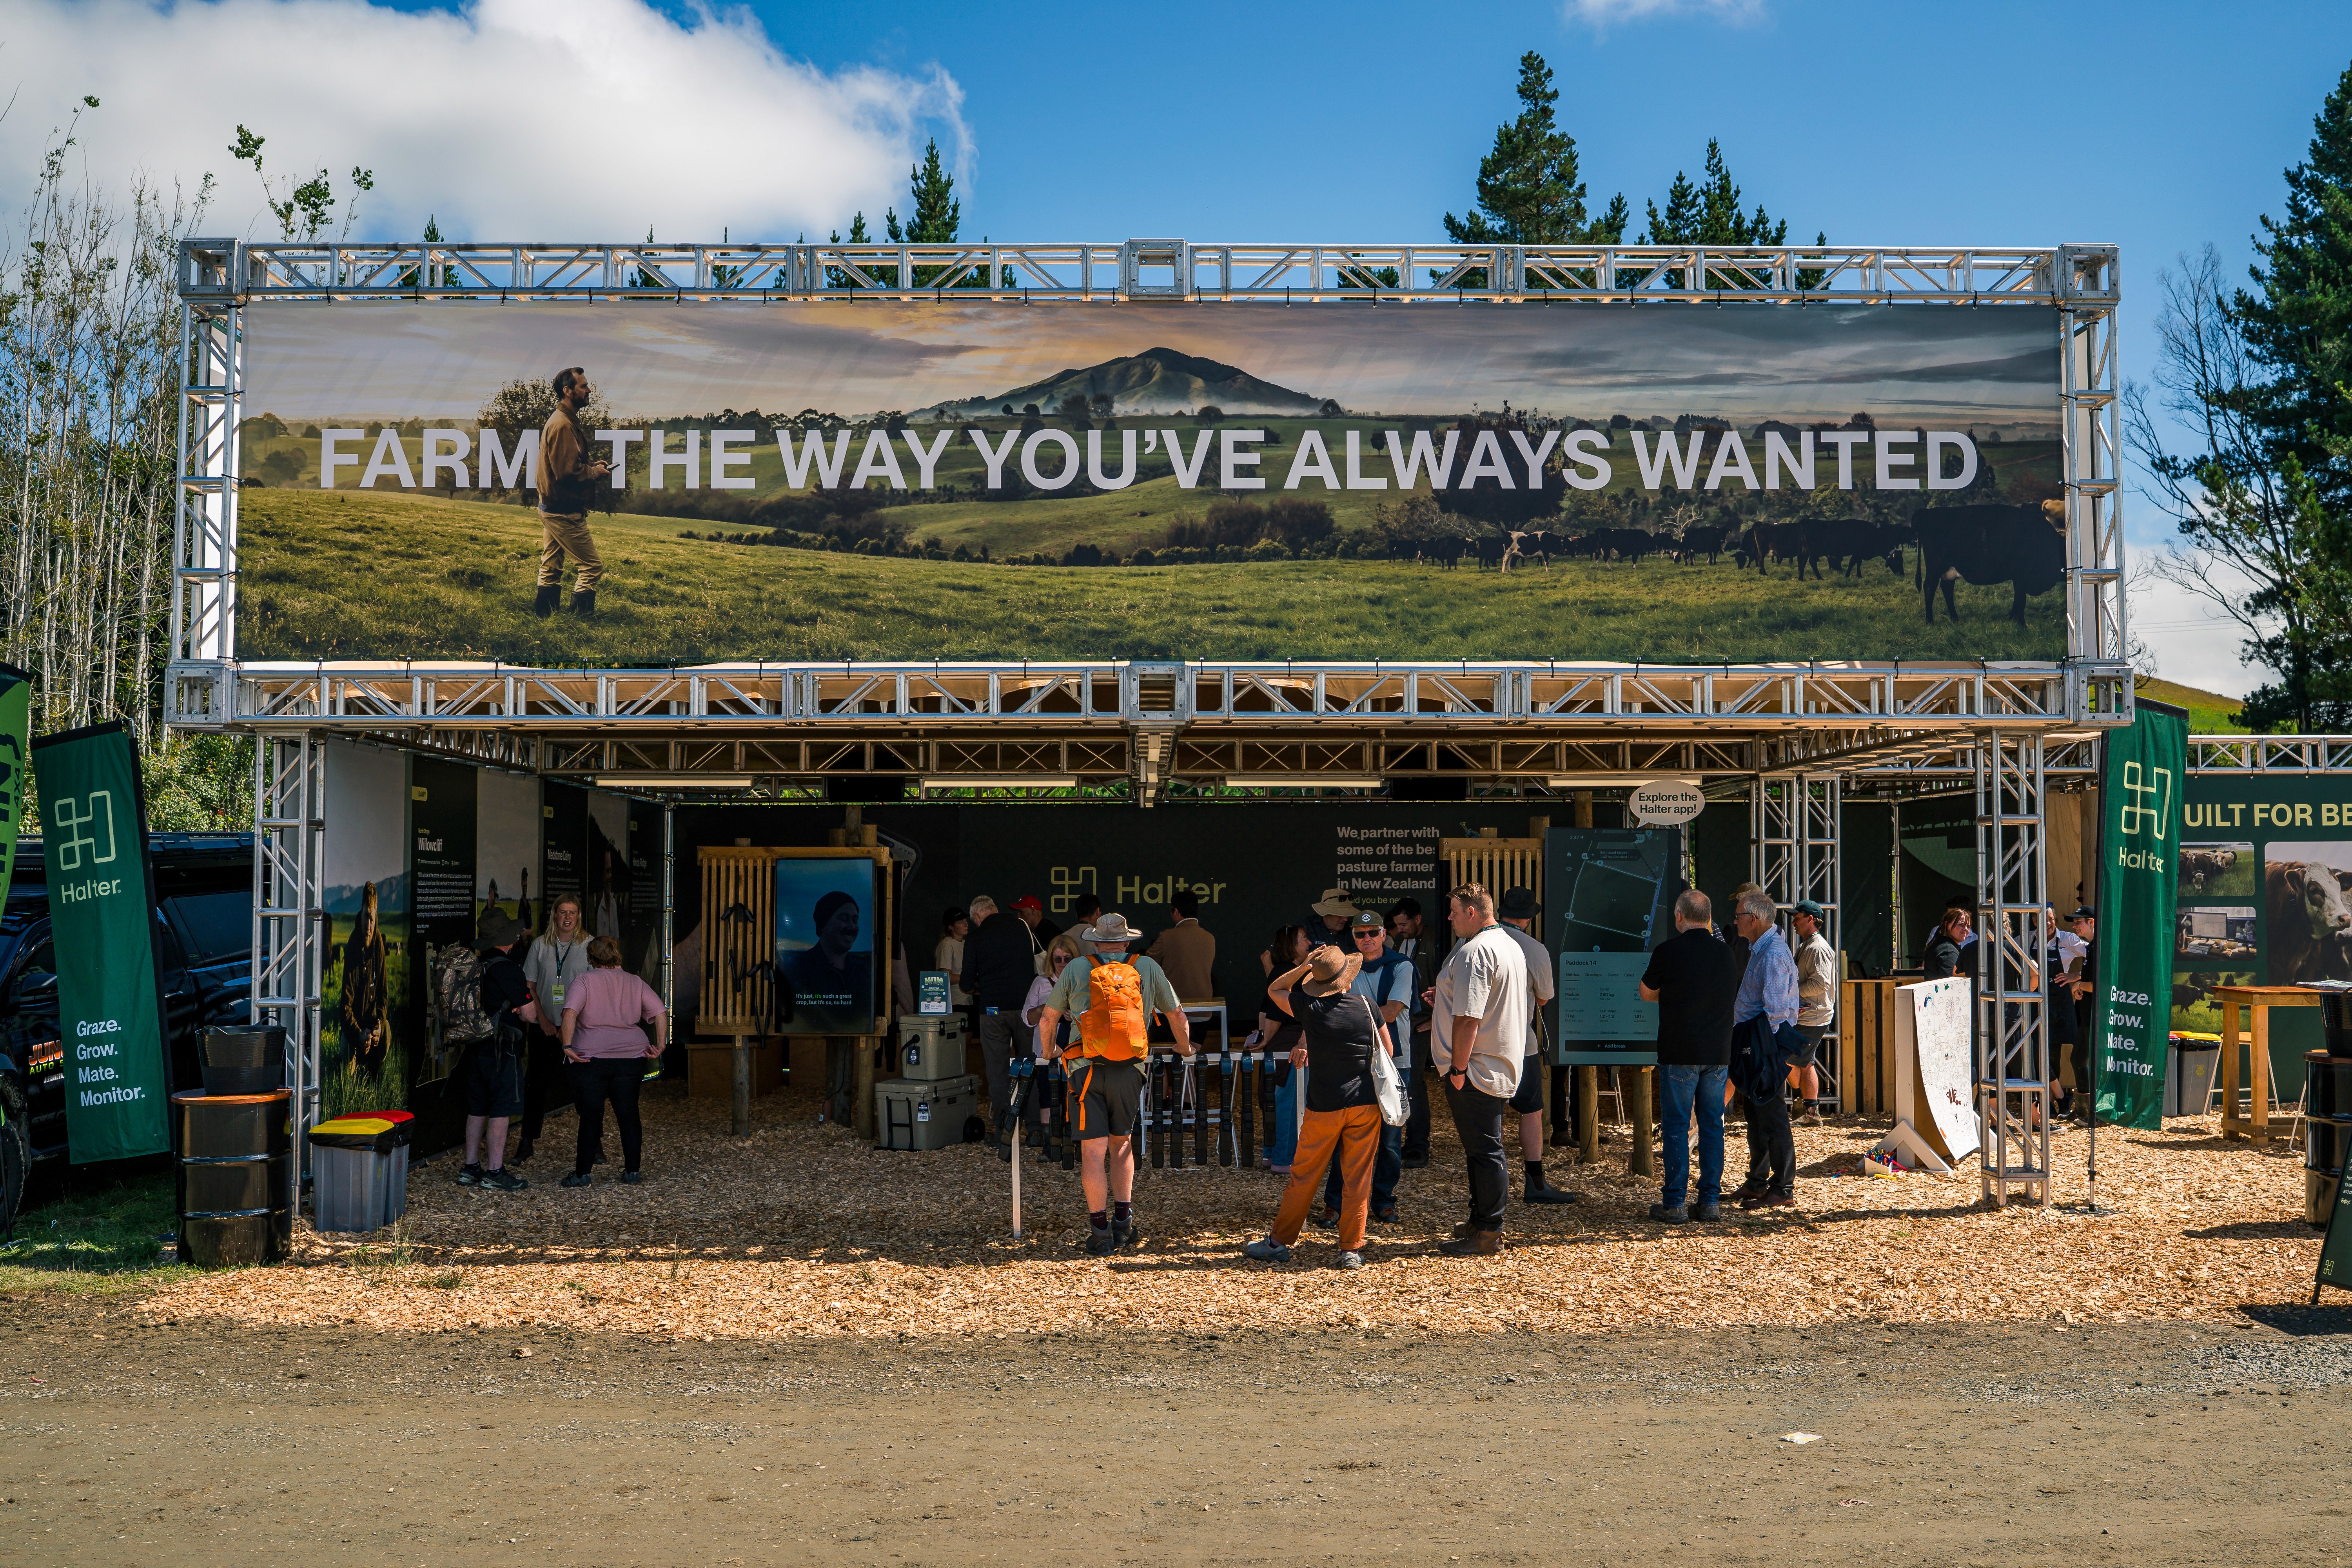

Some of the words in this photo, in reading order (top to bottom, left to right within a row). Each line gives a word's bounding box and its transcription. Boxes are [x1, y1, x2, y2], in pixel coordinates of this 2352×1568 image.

[320, 429, 538, 488] FARM
[595, 430, 756, 489] THE
[776, 430, 954, 489] WAY
[968, 428, 1266, 490] YOU'VE
[1283, 429, 1612, 490] ALWAYS
[1630, 430, 1978, 490] WANTED
[1639, 792, 1678, 803] Explore
[1681, 792, 1698, 801] the
[1640, 804, 1671, 813] Halter
[1673, 804, 1697, 815] app!
[2185, 804, 2246, 826] UILT
[2254, 804, 2313, 826] FOR
[2322, 804, 2352, 826] BE
[1337, 827, 1358, 838] We
[1361, 828, 1410, 840] partner
[1412, 827, 1439, 838] with
[418, 837, 442, 851] Willowcliff
[1337, 846, 1373, 855] some
[1376, 844, 1389, 855] of
[1392, 844, 1413, 855] the
[1337, 862, 1387, 874] pasture
[1337, 878, 1348, 889] in
[1352, 878, 1381, 889] New
[1383, 878, 1435, 889] Zealand
[924, 977, 944, 985] WIN
[2111, 985, 2152, 1006] Graze.
[2109, 1009, 2143, 1028] Grow.
[77, 1020, 122, 1036] Graze.
[29, 1040, 64, 1066] JUN
[77, 1044, 118, 1060] Grow.
[29, 1062, 54, 1075] AUTO
[2106, 1056, 2153, 1076] Monitor.
[78, 1066, 119, 1083] Mate.
[80, 1087, 145, 1107] Monitor.
